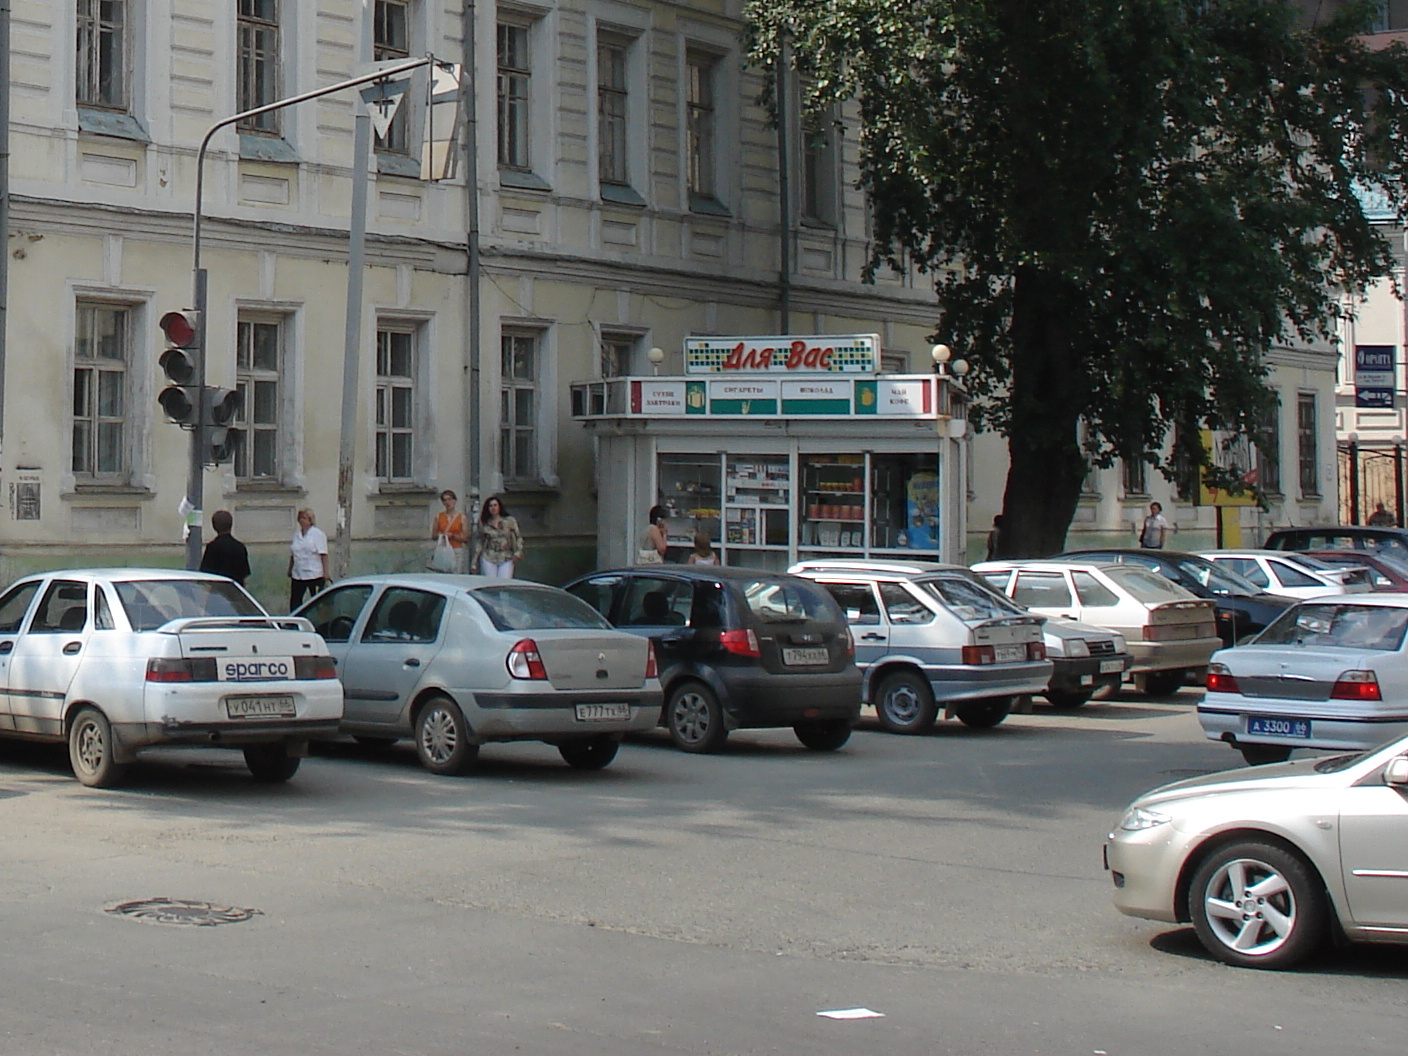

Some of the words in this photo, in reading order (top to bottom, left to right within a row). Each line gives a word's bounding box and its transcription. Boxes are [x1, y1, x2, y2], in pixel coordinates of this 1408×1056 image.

[722, 342, 774, 370] Для
[786, 340, 834, 369] Вас
[225, 662, 288, 681] sparco
[1253, 721, 1260, 731] А
[1263, 719, 1290, 733] 3300
